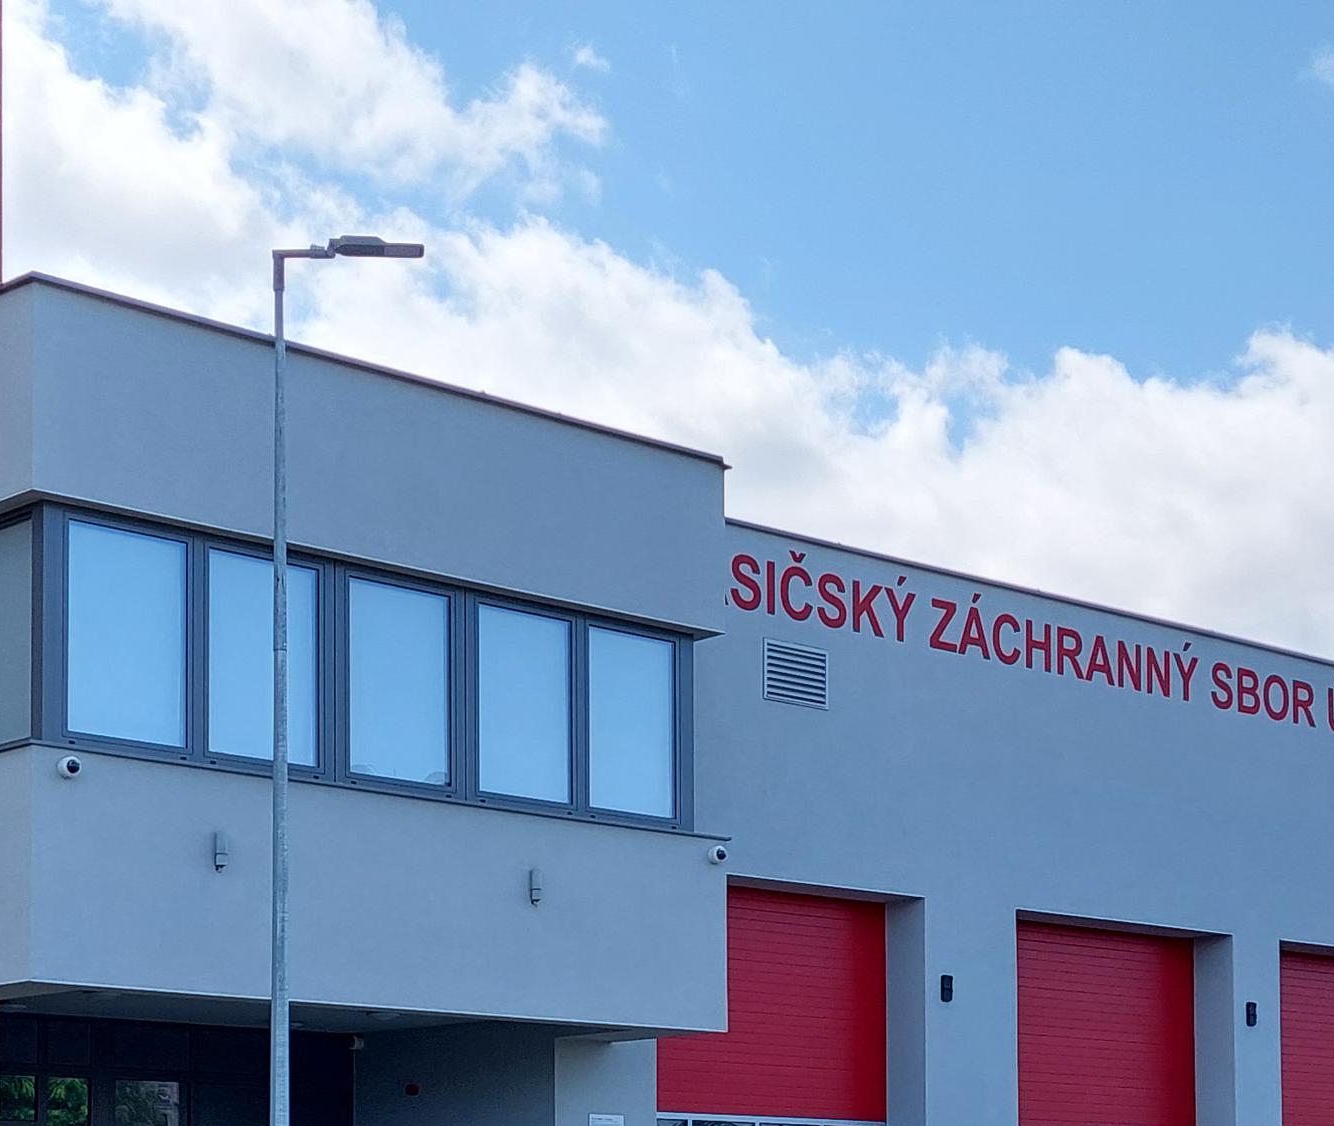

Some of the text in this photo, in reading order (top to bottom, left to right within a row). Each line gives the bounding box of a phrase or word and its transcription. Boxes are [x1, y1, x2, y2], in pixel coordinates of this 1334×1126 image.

[725, 550, 916, 642] SIČSKÝ
[929, 593, 1199, 702] ZÁCHRANNÝ
[1211, 661, 1316, 728] SBOR
